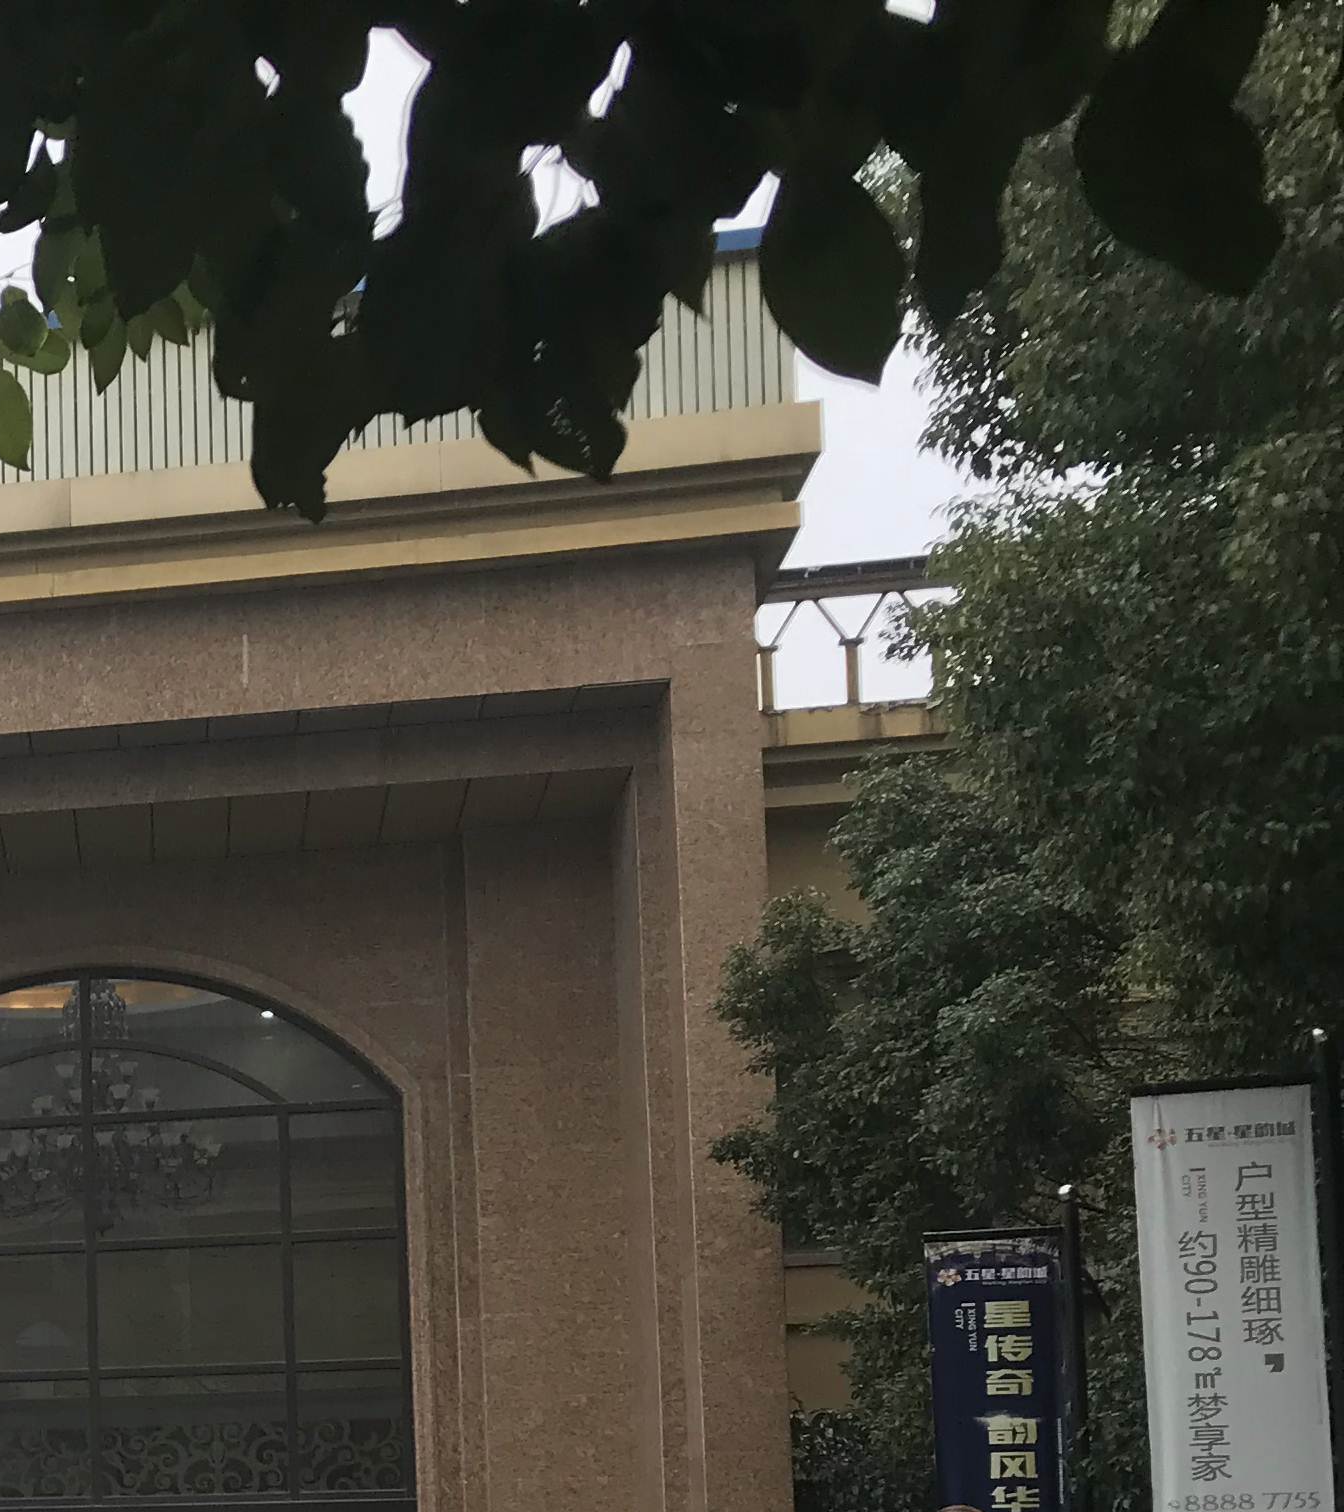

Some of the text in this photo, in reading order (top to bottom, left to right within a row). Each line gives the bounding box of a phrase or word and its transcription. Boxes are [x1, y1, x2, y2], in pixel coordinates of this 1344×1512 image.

[954, 1308, 964, 1330] CITY
[967, 1308, 977, 1331] XING
[984, 1300, 1034, 1396] 星传奇
[1184, 1491, 1321, 1512] 8888 7755
